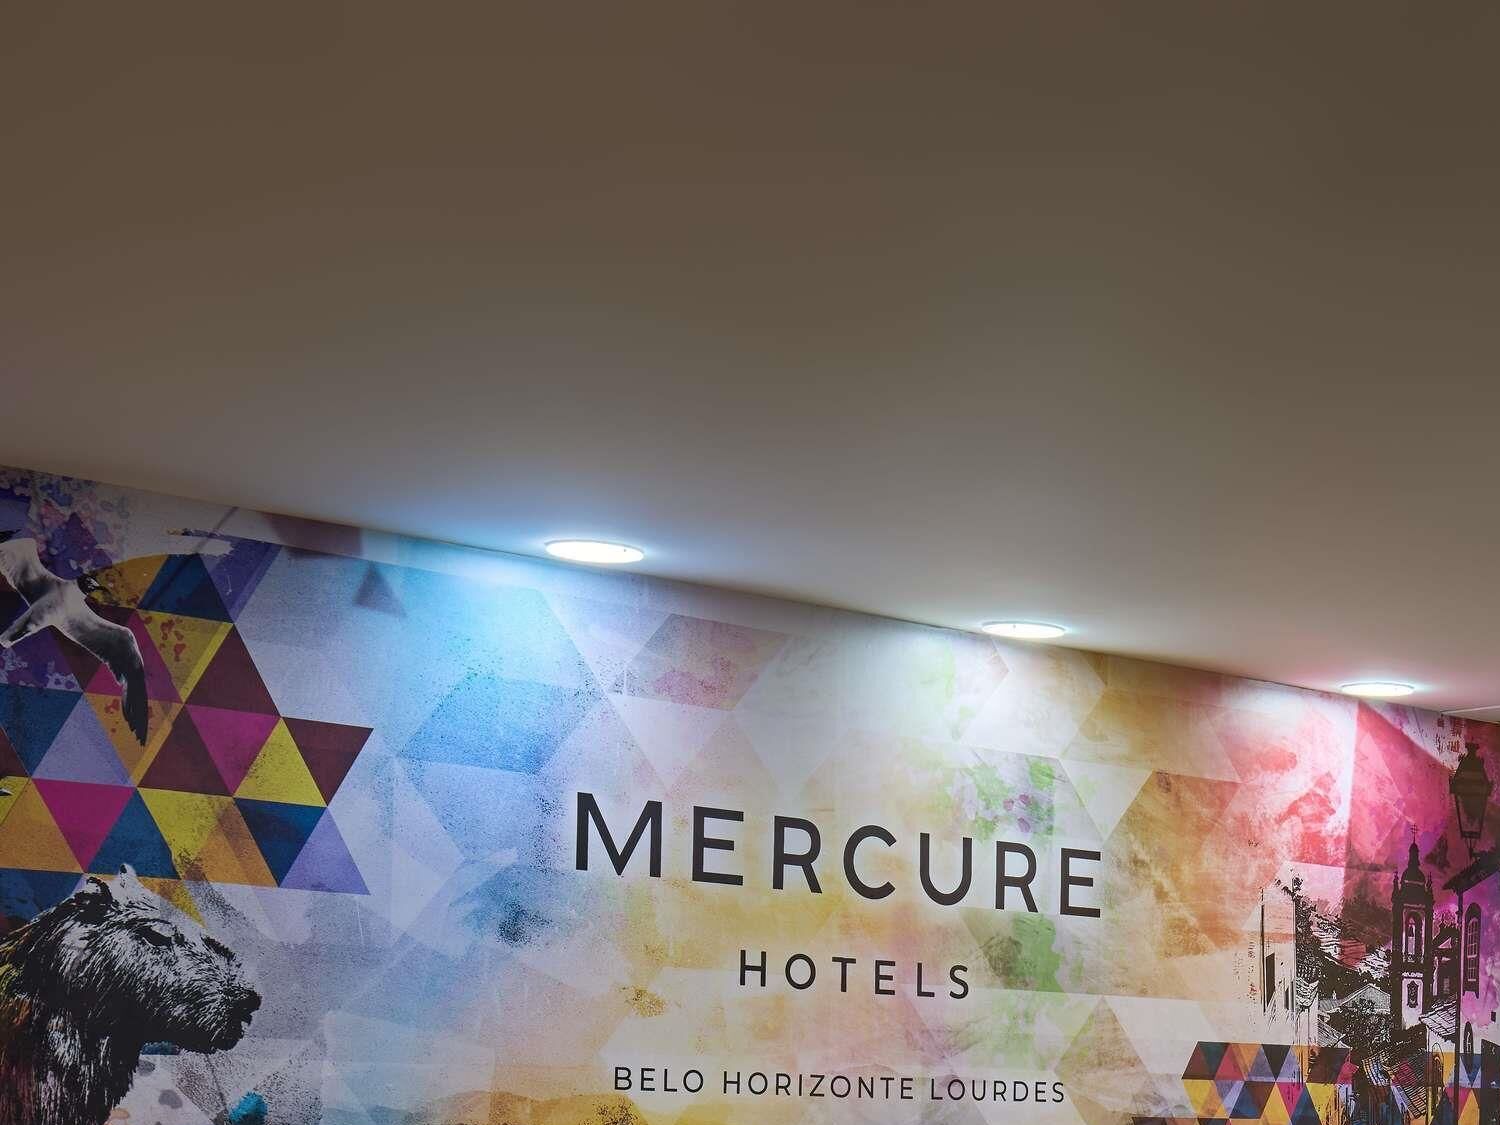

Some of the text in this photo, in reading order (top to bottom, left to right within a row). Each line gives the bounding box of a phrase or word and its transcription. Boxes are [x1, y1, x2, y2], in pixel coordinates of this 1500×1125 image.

[575, 791, 1102, 919] MERCURE
[739, 949, 970, 1000] HOTELS
[614, 1066, 1065, 1103] BELO HORIZONTE LOURDES
